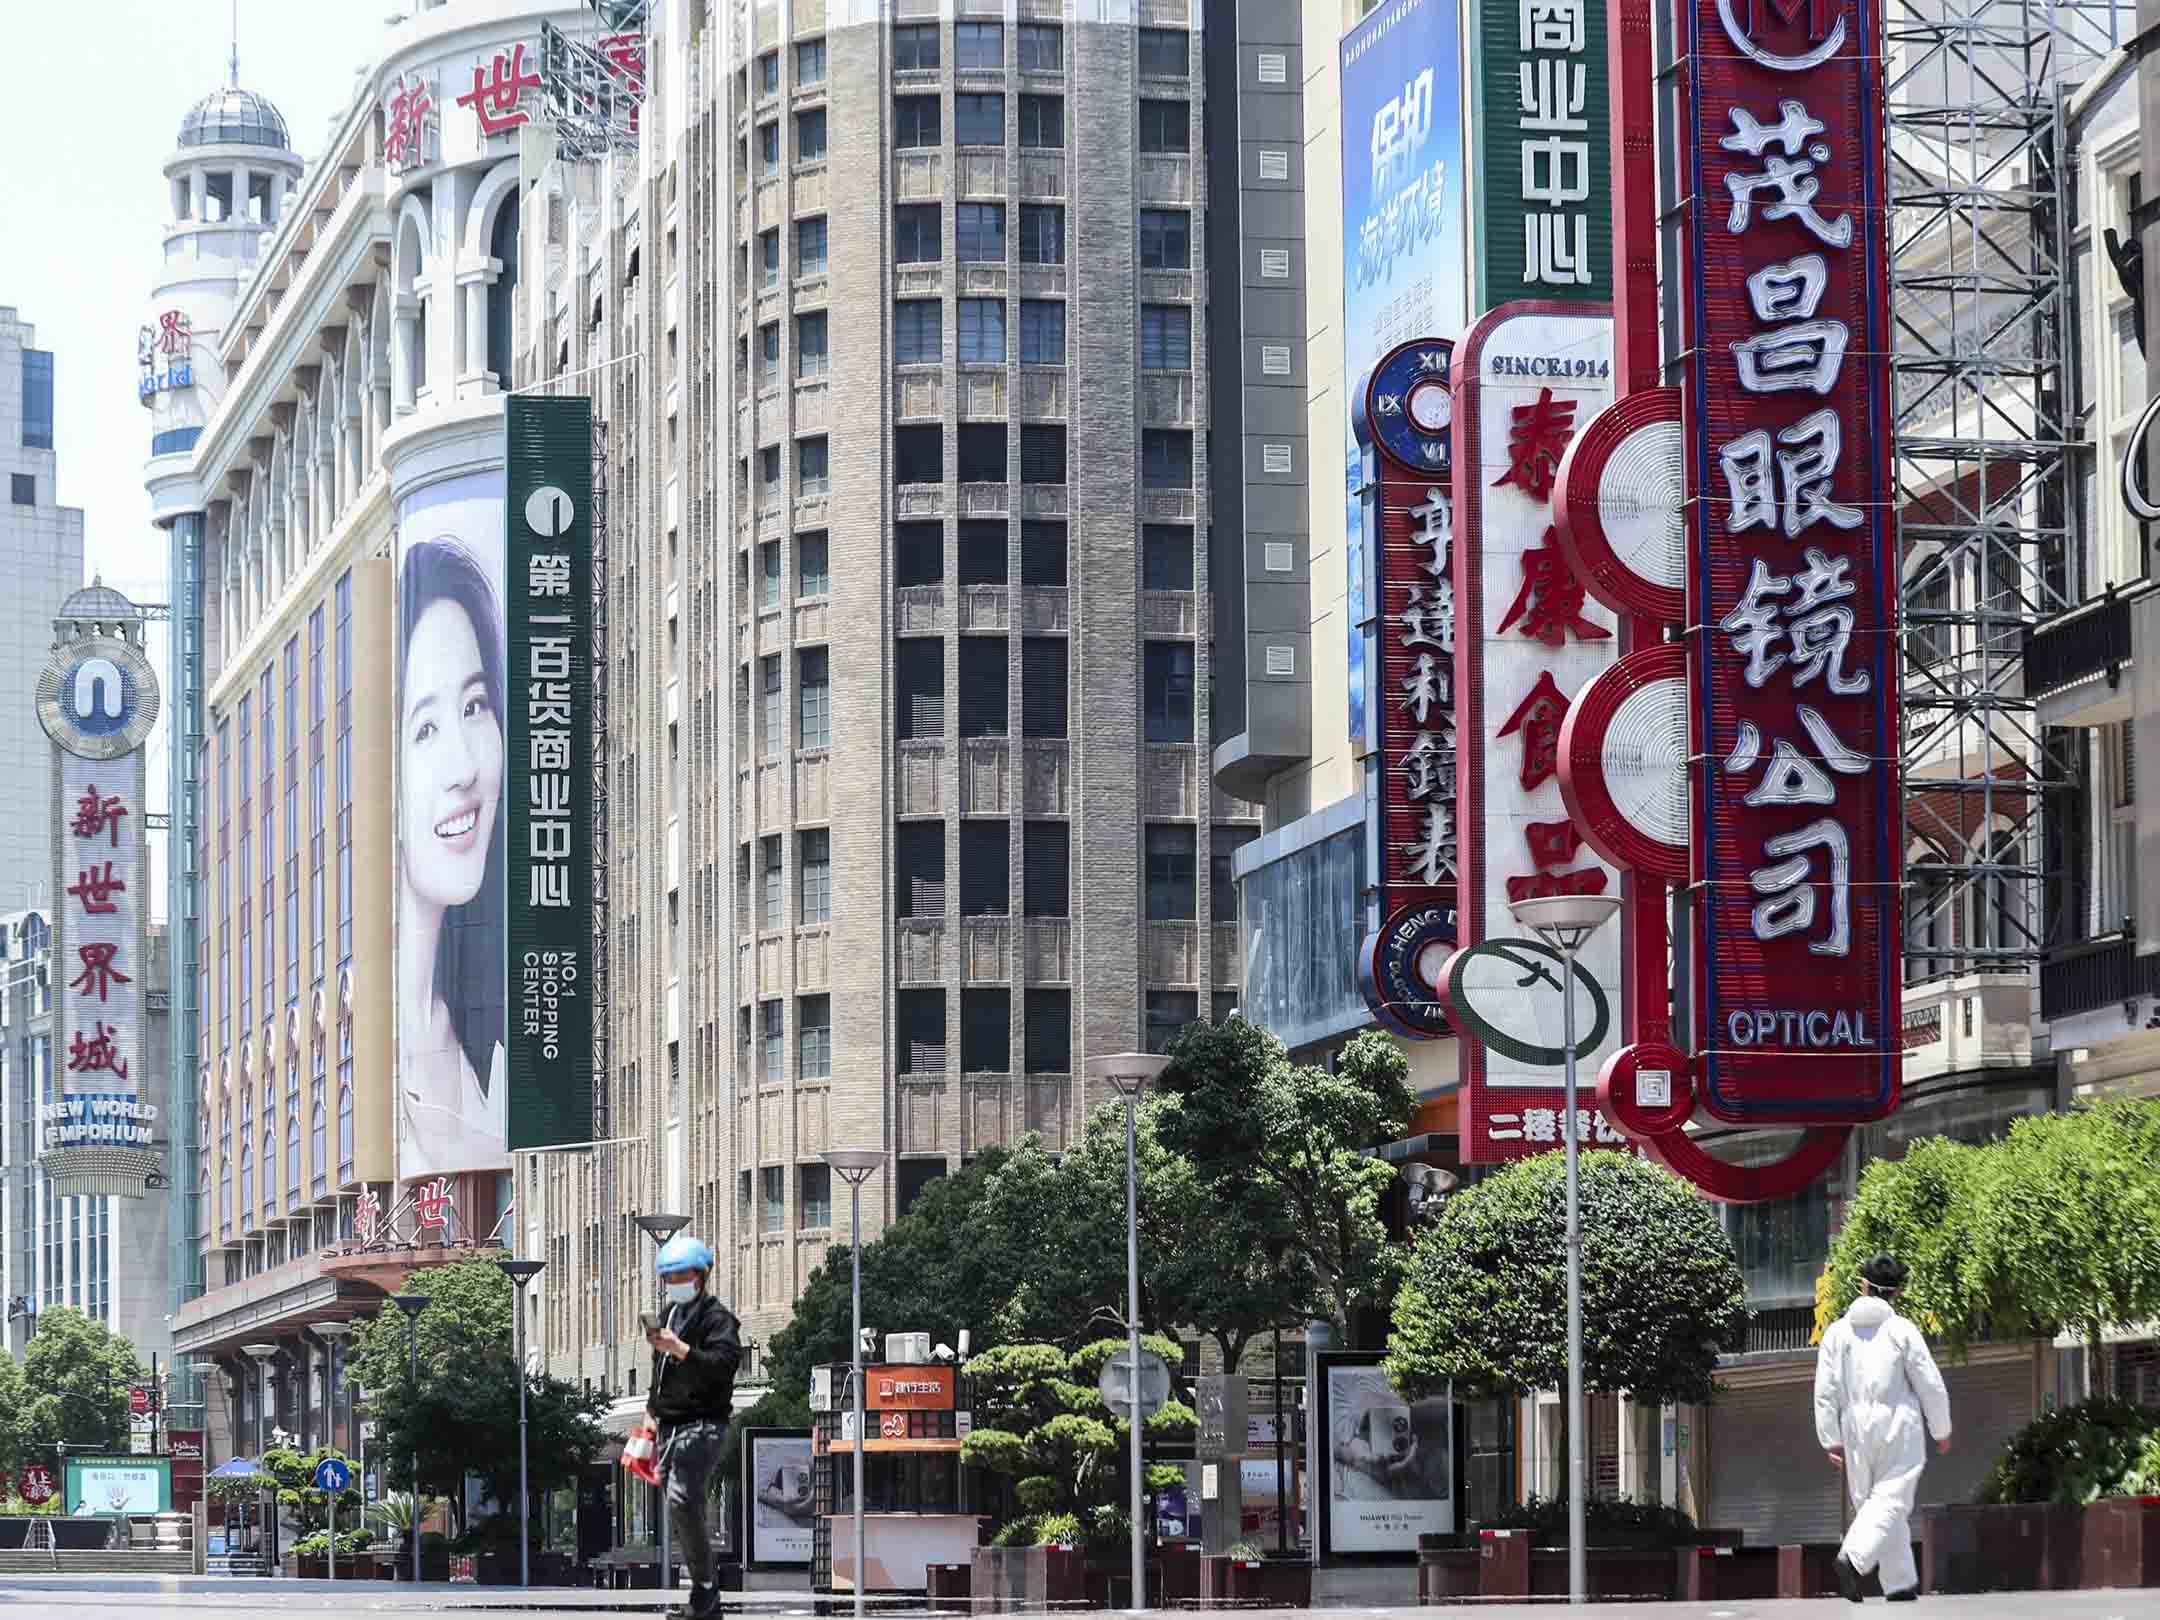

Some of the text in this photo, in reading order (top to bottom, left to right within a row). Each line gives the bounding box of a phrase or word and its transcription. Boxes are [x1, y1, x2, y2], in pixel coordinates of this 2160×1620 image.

[1491, 355, 1610, 378] SINCE1914
[1378, 397, 1401, 414] IX
[1719, 100, 1872, 958] 茂昌眼镜公司
[1490, 387, 1613, 902] 泰康食品
[529, 554, 572, 907] 第一百货商业中心
[67, 784, 131, 1081] 新世界城
[1391, 909, 1441, 951] HENG
[523, 952, 540, 1035] CENTER
[561, 952, 577, 997] NO.1
[542, 952, 558, 1060] SHOPPING
[1728, 1009, 1875, 1047] OPTICAL
[41, 1101, 159, 1121] NEW WORLD
[45, 1124, 153, 1145] EMPORIUM
